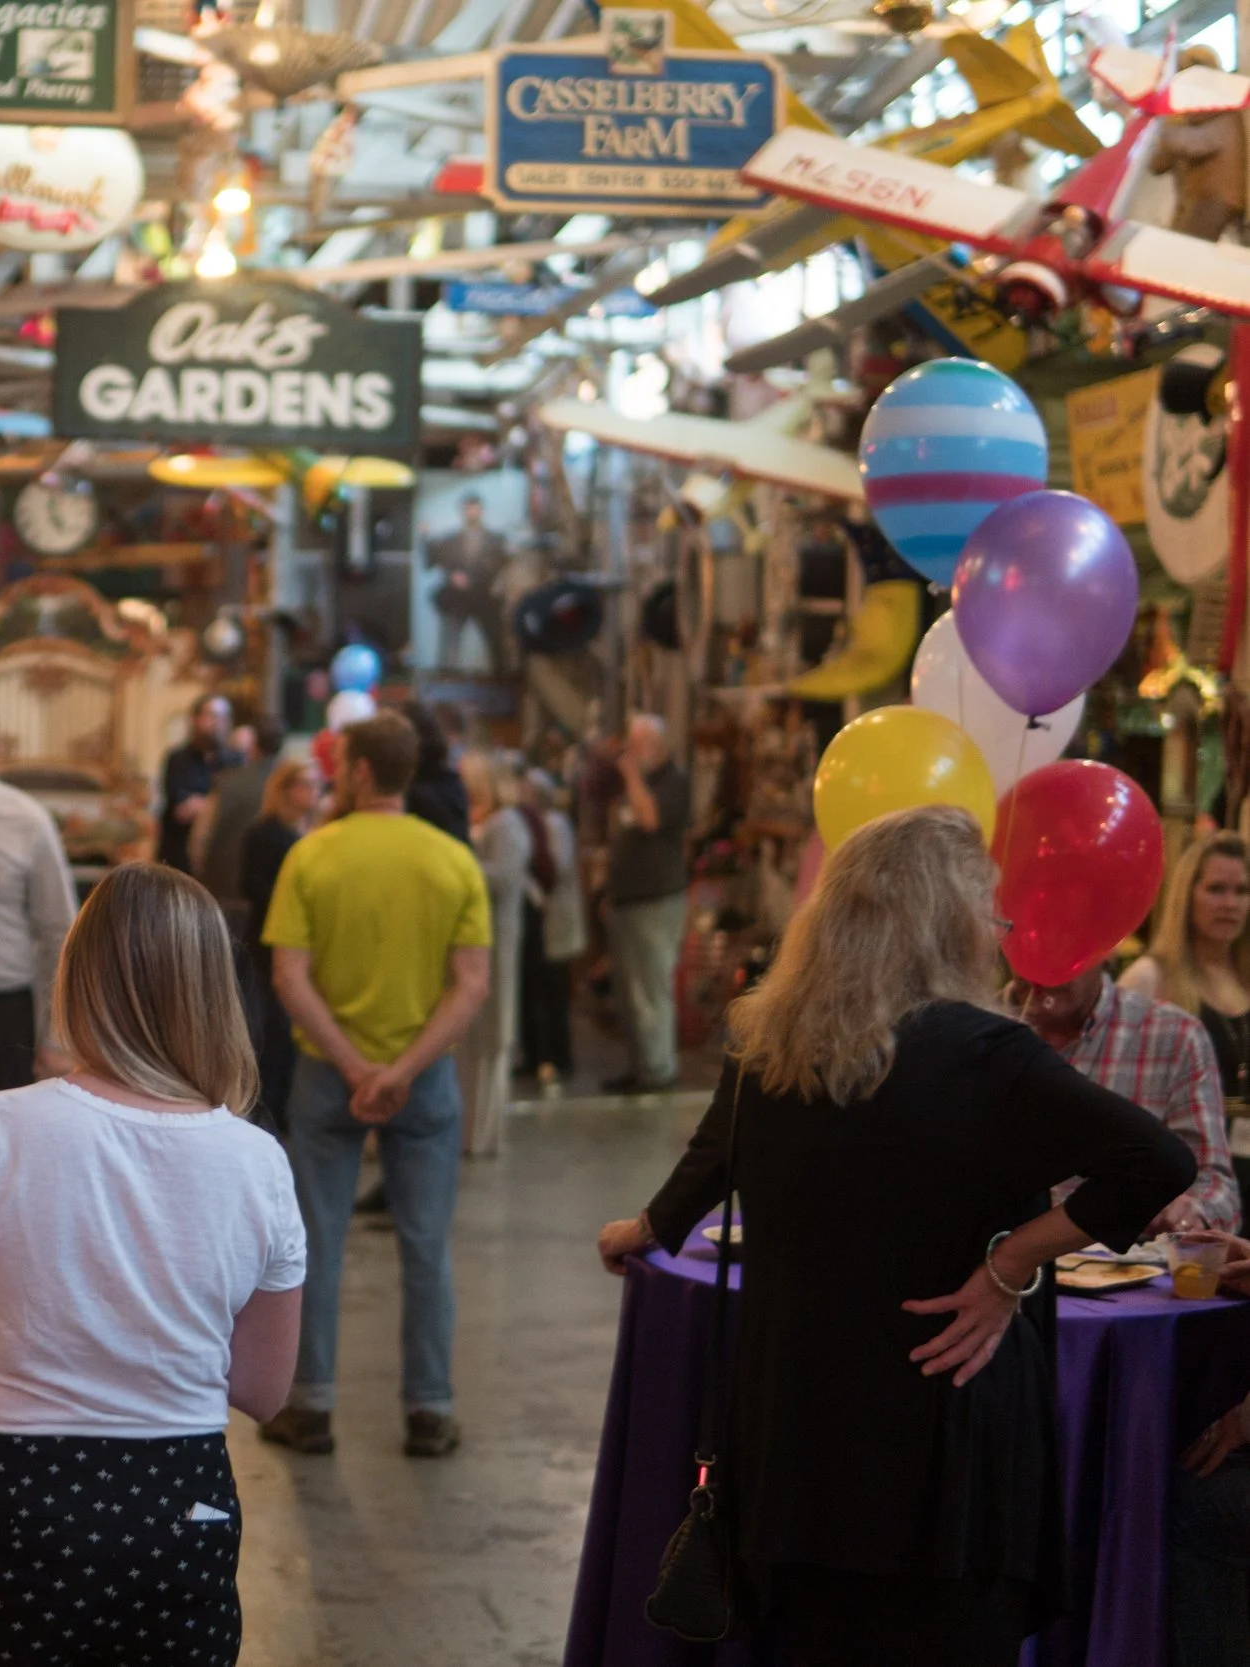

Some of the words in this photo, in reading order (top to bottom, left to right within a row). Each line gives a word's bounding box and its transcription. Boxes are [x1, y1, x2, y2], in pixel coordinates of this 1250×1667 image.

[23, 80, 93, 105] Poetry
[506, 76, 762, 127] CASSELBERRY
[582, 113, 690, 160] FARM
[79, 364, 395, 431] GARDENS
